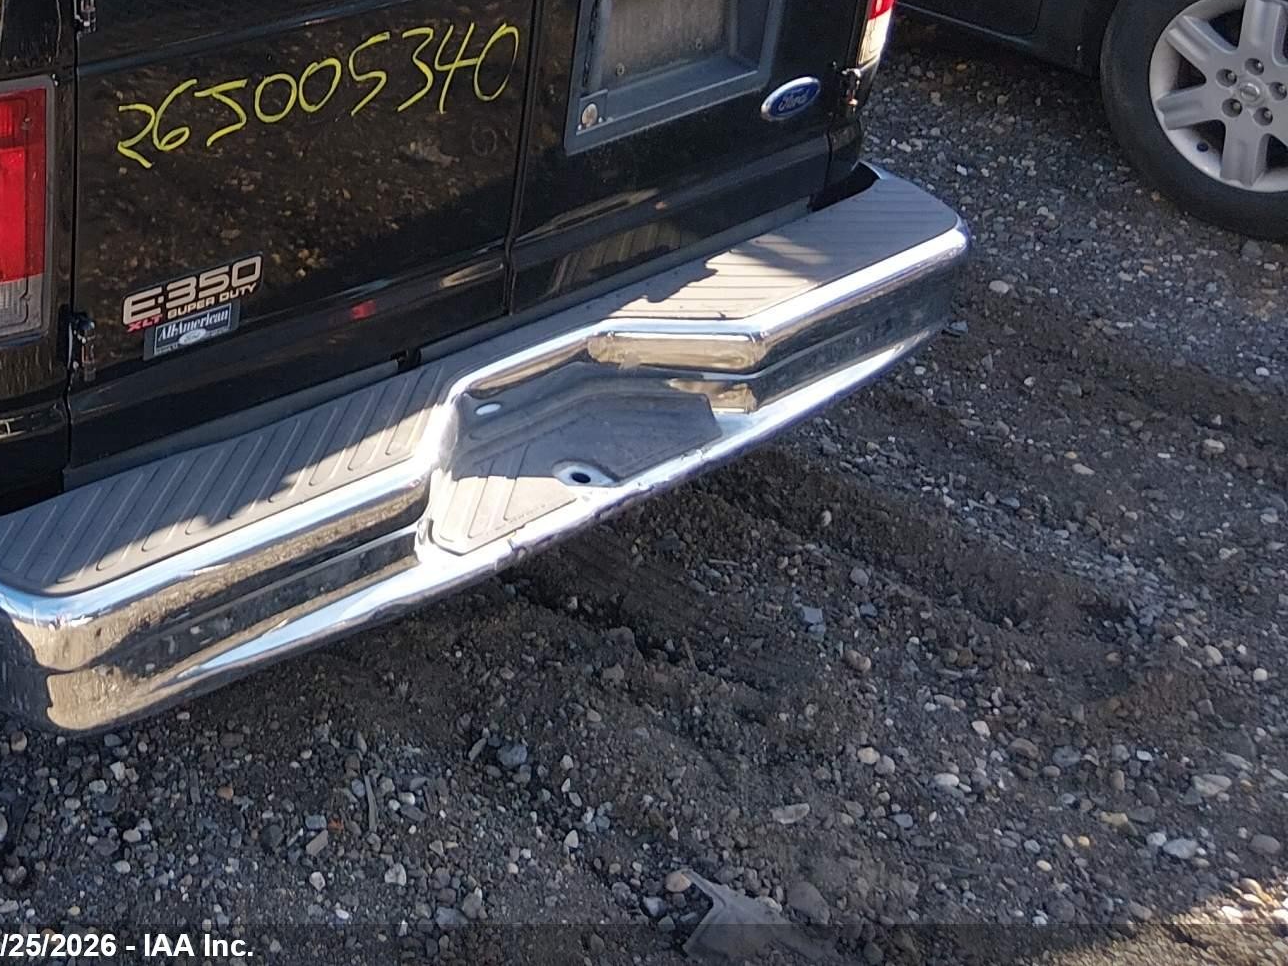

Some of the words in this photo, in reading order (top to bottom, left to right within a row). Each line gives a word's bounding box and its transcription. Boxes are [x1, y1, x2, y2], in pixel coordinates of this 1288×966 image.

[117, 22, 520, 170] 265005340
[167, 295, 216, 320] SUPER
[219, 282, 257, 304] DUTY
[126, 314, 164, 333] XLT
